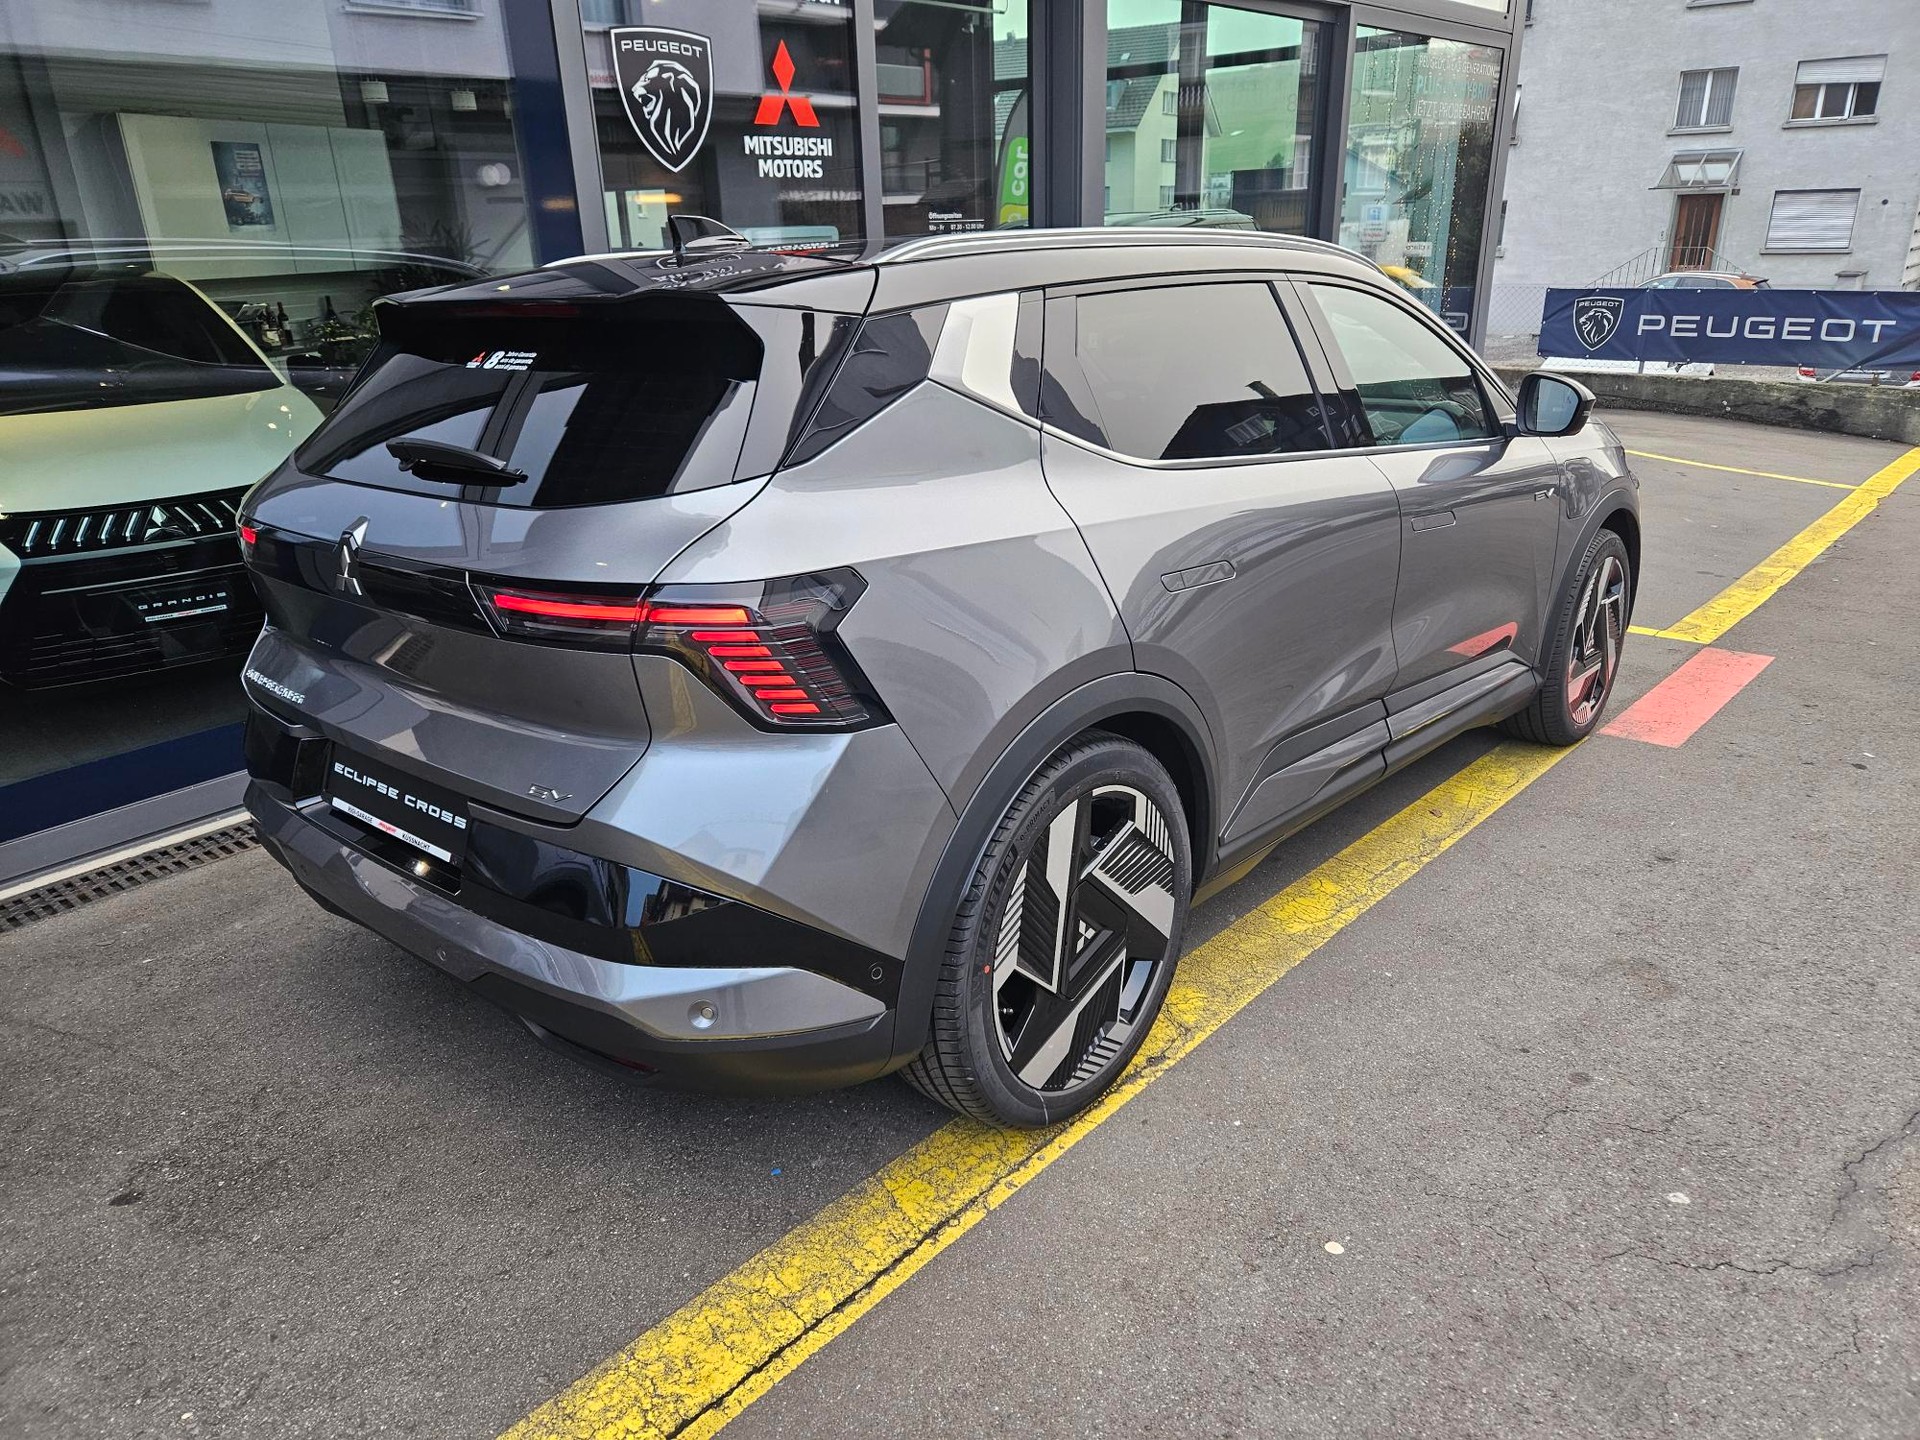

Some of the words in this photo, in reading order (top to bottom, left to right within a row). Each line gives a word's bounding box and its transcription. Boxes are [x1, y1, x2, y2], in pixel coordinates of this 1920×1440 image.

[621, 39, 703, 58] PEUGEOT
[743, 135, 833, 157] MITSUBISHI
[758, 159, 824, 178] MOTORS
[1579, 300, 1620, 308] PEUGEOT
[1637, 314, 1897, 343] PEUGEOT
[483, 350, 506, 369] 8
[1534, 487, 1555, 501] EV
[138, 591, 227, 610] GRANDIS
[334, 762, 400, 800] ECLIPSE
[404, 794, 467, 830] CROSS
[528, 783, 573, 802] EV
